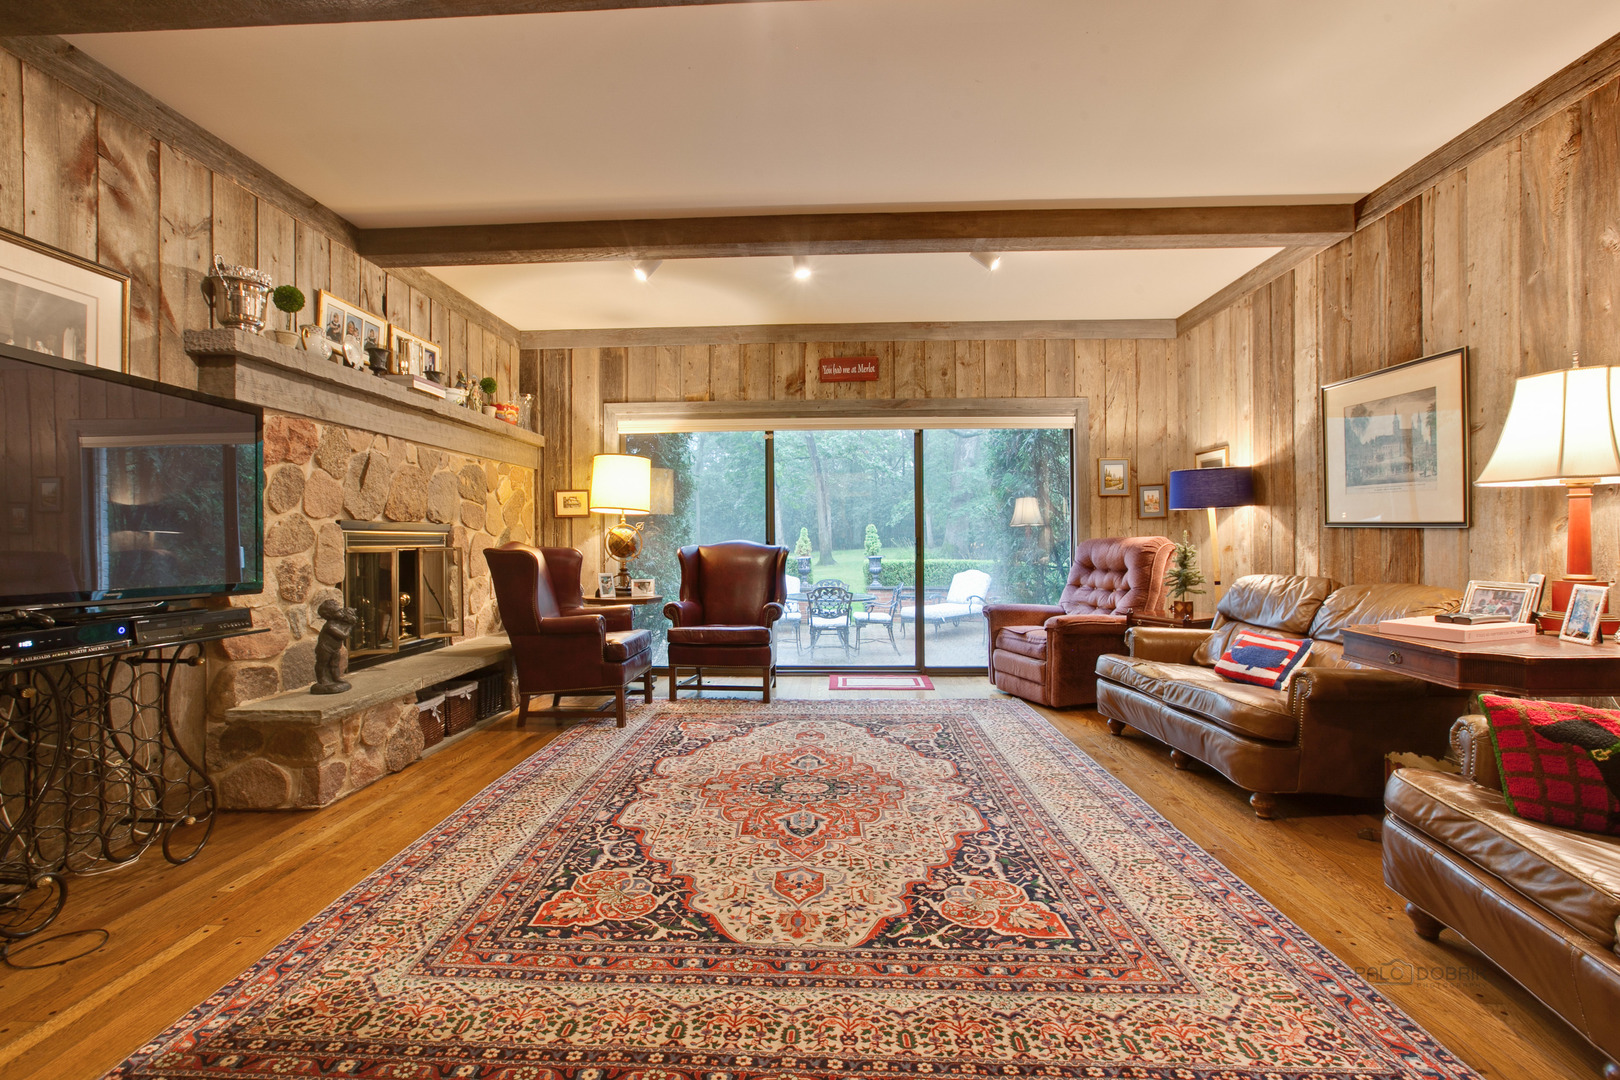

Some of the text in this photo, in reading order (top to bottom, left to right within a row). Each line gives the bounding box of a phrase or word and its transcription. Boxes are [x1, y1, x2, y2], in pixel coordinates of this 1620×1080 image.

[823, 365, 832, 374] You
[832, 363, 842, 375] had
[851, 366, 857, 374] at
[858, 362, 875, 373] Merlot
[20, 654, 51, 663] RAILROADS
